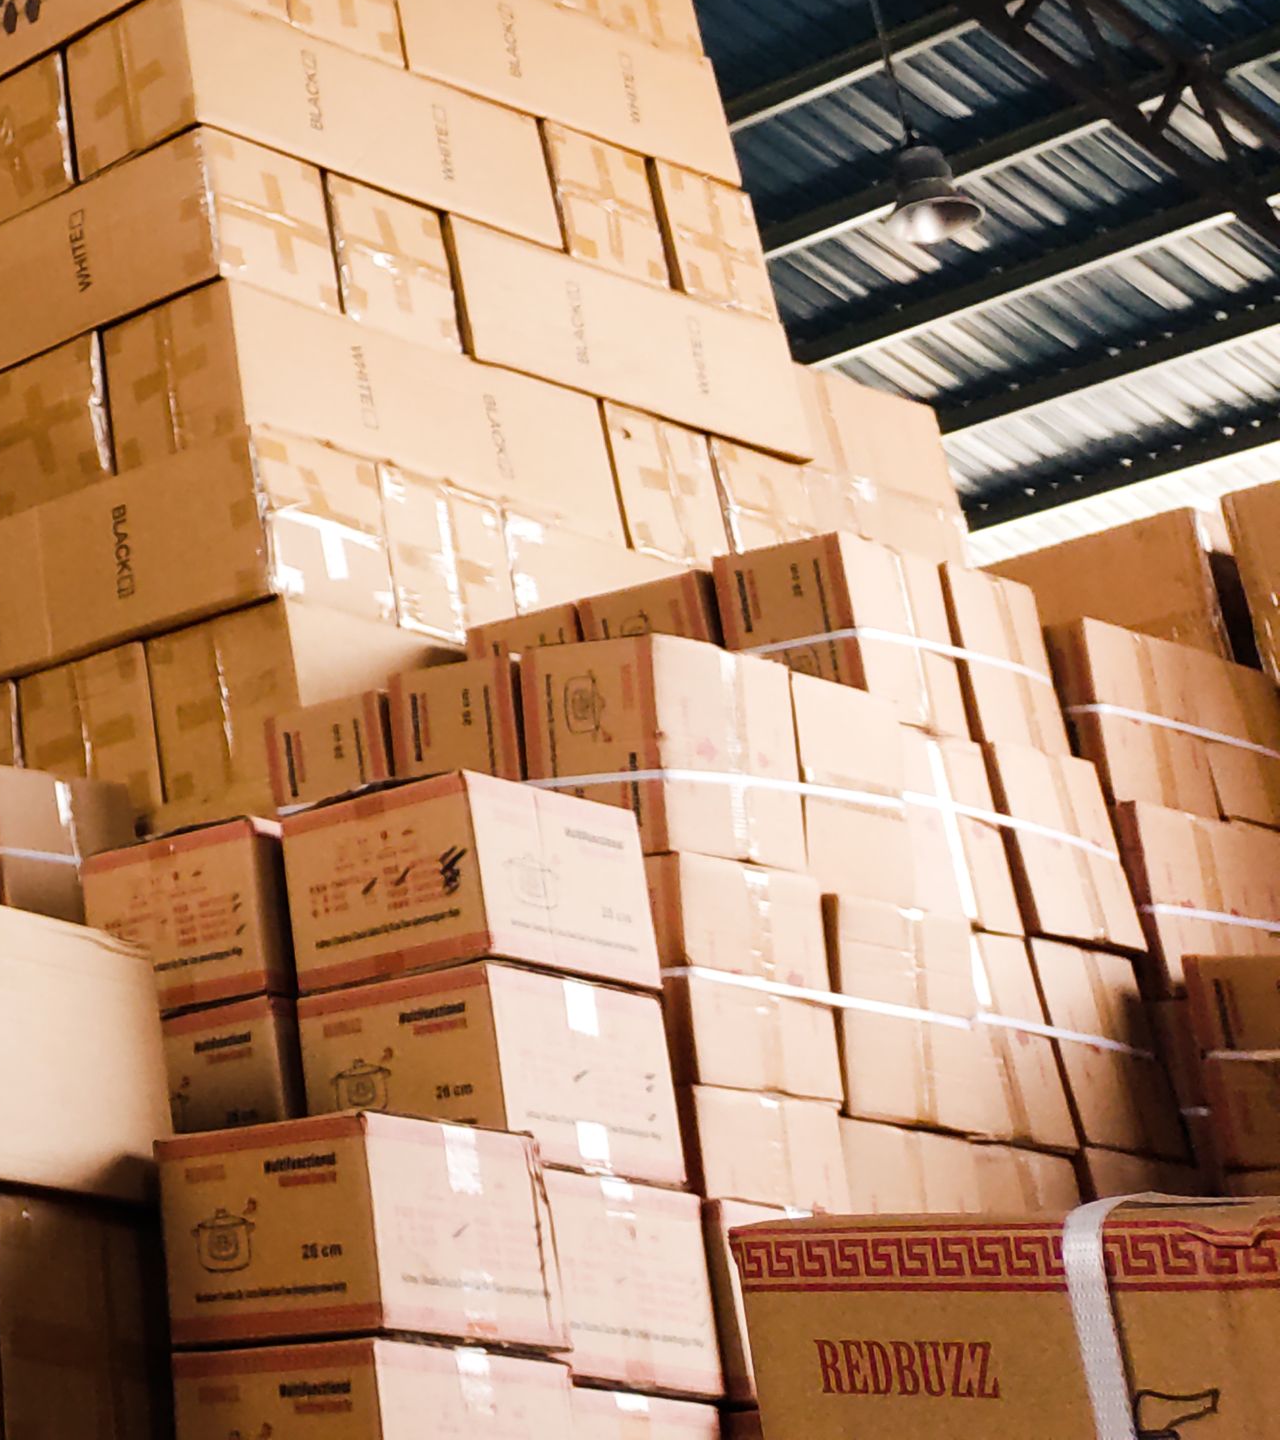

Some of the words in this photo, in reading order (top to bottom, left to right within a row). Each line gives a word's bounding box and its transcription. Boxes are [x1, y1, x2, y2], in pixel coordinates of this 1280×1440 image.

[305, 72, 324, 130] BLACK
[69, 228, 92, 292] WHITE
[112, 504, 131, 581] BLACK
[814, 1339, 1001, 1399] REDBUZZ
